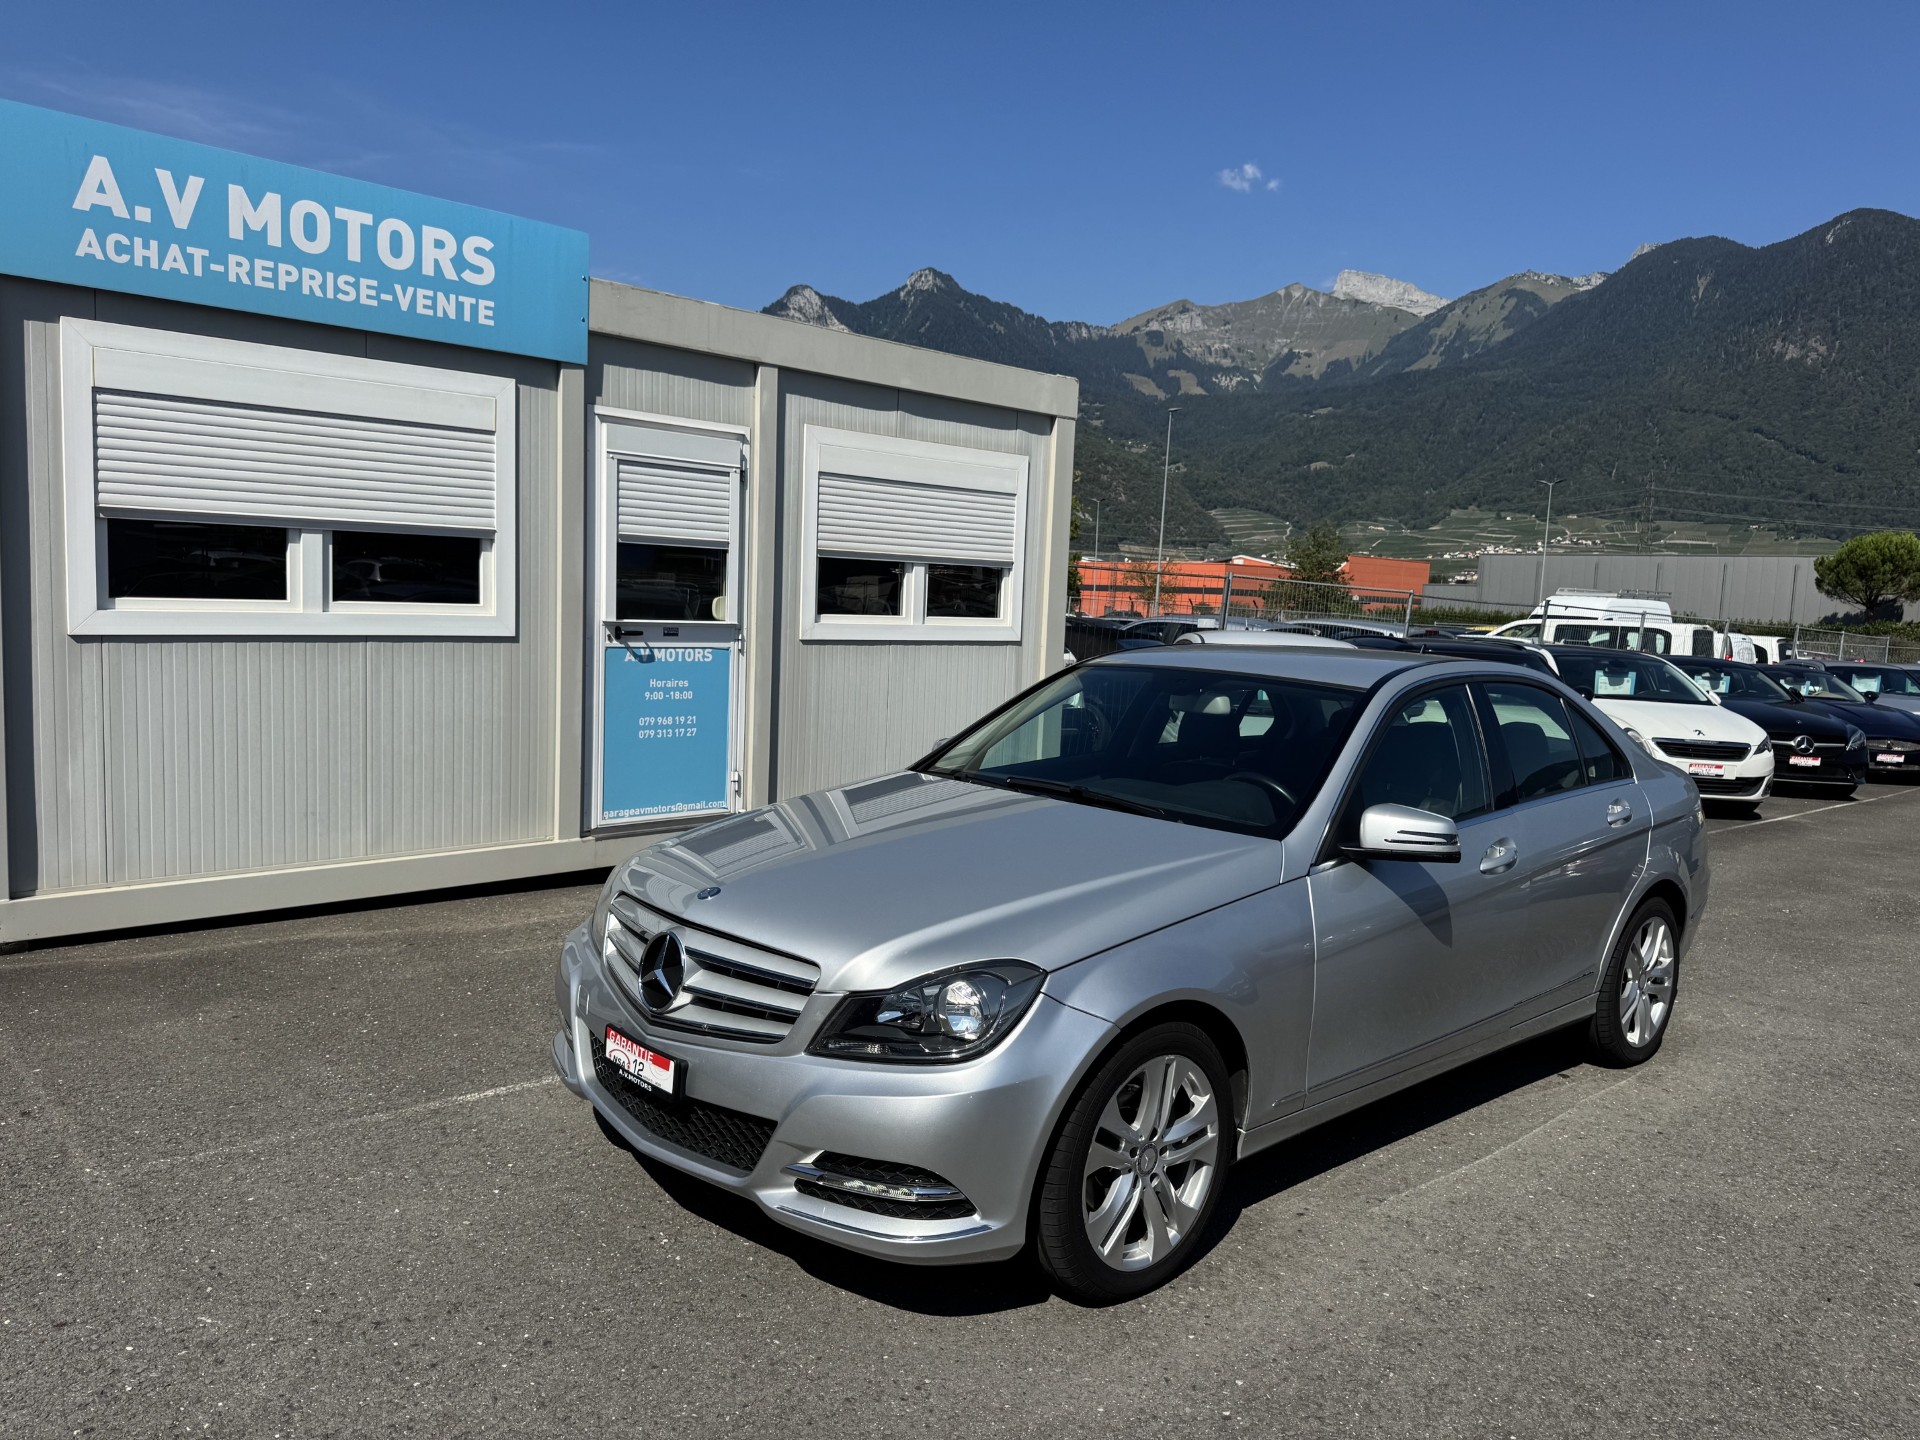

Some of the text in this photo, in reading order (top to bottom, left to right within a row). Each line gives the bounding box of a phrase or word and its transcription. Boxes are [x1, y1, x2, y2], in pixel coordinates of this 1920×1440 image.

[72, 154, 496, 286] A.V MOTORS
[75, 228, 496, 327] ACHAT-REPRISE-VENTE
[654, 648, 713, 662] MOTORS
[649, 678, 689, 688] Horaires
[644, 691, 664, 700] 9:00
[639, 715, 697, 726] 079 968 19 21
[639, 728, 697, 739] 079 313 17 27
[603, 800, 727, 820] garageavmotors@gmail.com
[609, 1030, 653, 1064] GARANTIE
[632, 1058, 645, 1077] 12
